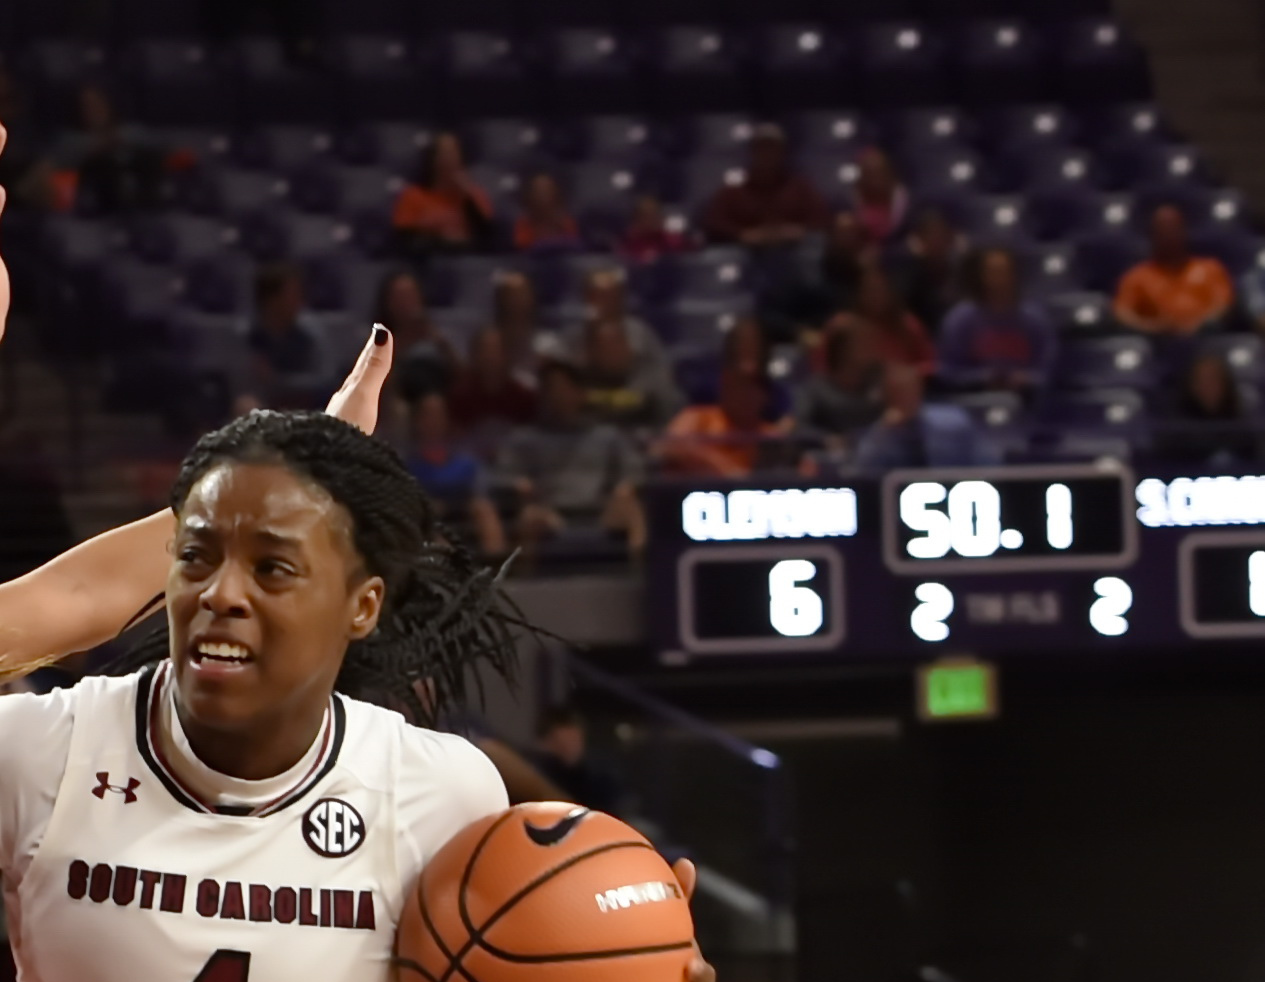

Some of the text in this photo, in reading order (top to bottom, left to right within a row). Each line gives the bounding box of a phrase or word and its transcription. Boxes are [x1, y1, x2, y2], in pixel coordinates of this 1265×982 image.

[769, 560, 823, 636] 6
[911, 582, 954, 641] 2
[1089, 577, 1133, 636] 2
[308, 800, 361, 853] SEC
[67, 859, 376, 931] SOUTH CAROLINA
